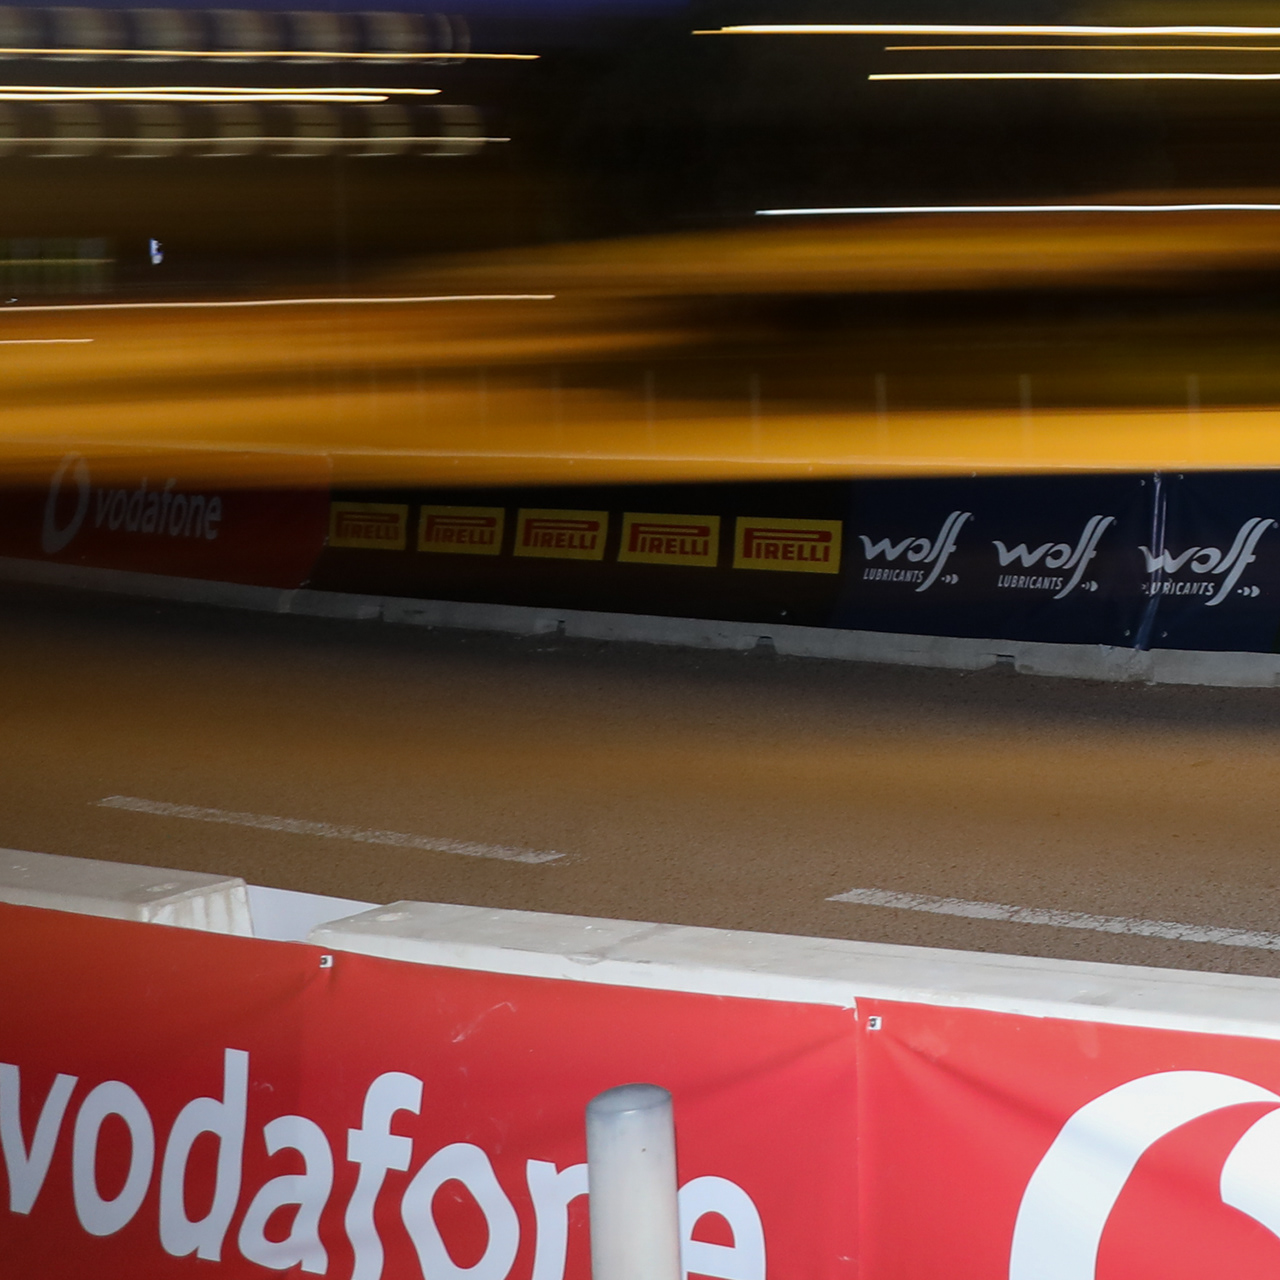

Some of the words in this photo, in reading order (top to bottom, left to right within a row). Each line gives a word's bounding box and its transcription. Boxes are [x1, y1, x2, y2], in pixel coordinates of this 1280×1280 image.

[95, 476, 222, 540] vodafone
[335, 510, 400, 540] PIRELLI
[425, 514, 496, 545] PIRELLI
[523, 518, 598, 551] PIRELLI
[628, 523, 711, 558] PIRELLI
[742, 527, 832, 563] PIRELLI
[858, 510, 972, 592] wolf
[992, 514, 1115, 599] wolf
[863, 568, 925, 584] LUBRICANTS
[998, 575, 1063, 591] LUBRICANTS
